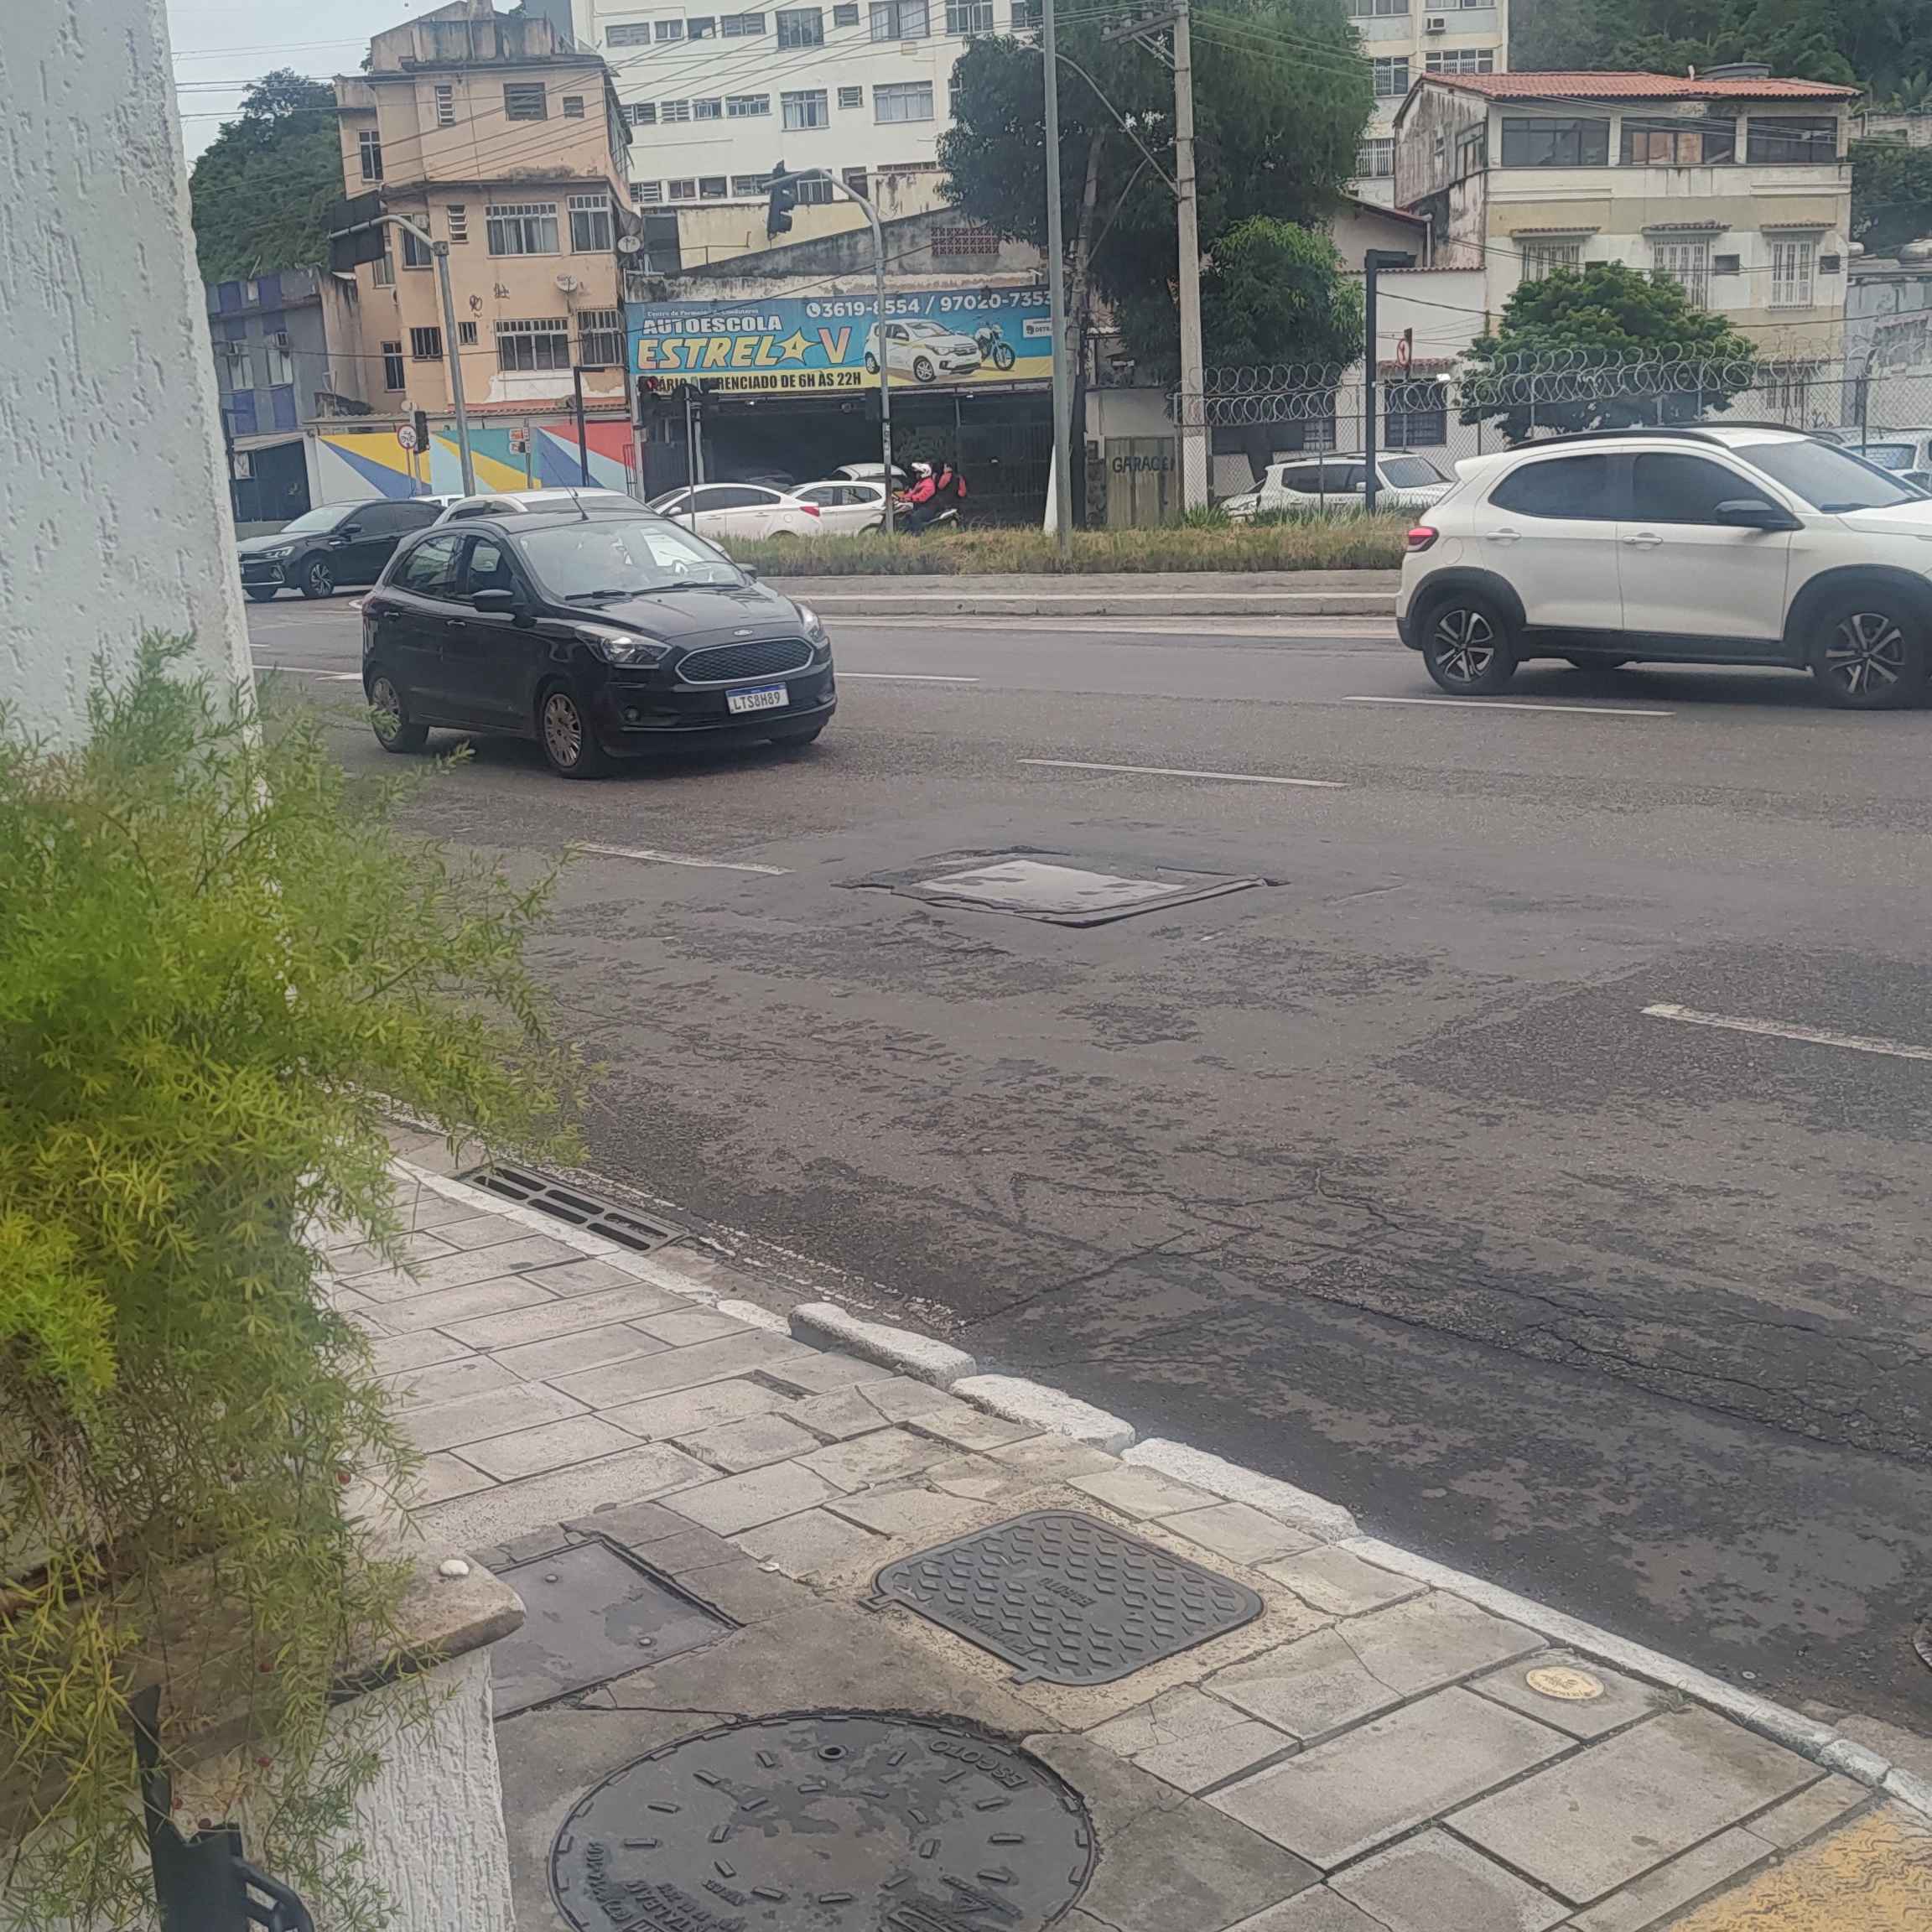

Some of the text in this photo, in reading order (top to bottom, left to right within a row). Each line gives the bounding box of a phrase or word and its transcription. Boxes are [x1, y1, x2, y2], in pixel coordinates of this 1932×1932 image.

[642, 315, 783, 335] AUTOESCOLA
[817, 326, 852, 365] V
[782, 372, 795, 388] DE
[798, 372, 815, 387] 6H
[818, 370, 834, 387] ÀS
[837, 371, 862, 387] 22H
[733, 692, 781, 710] LTS8H89
